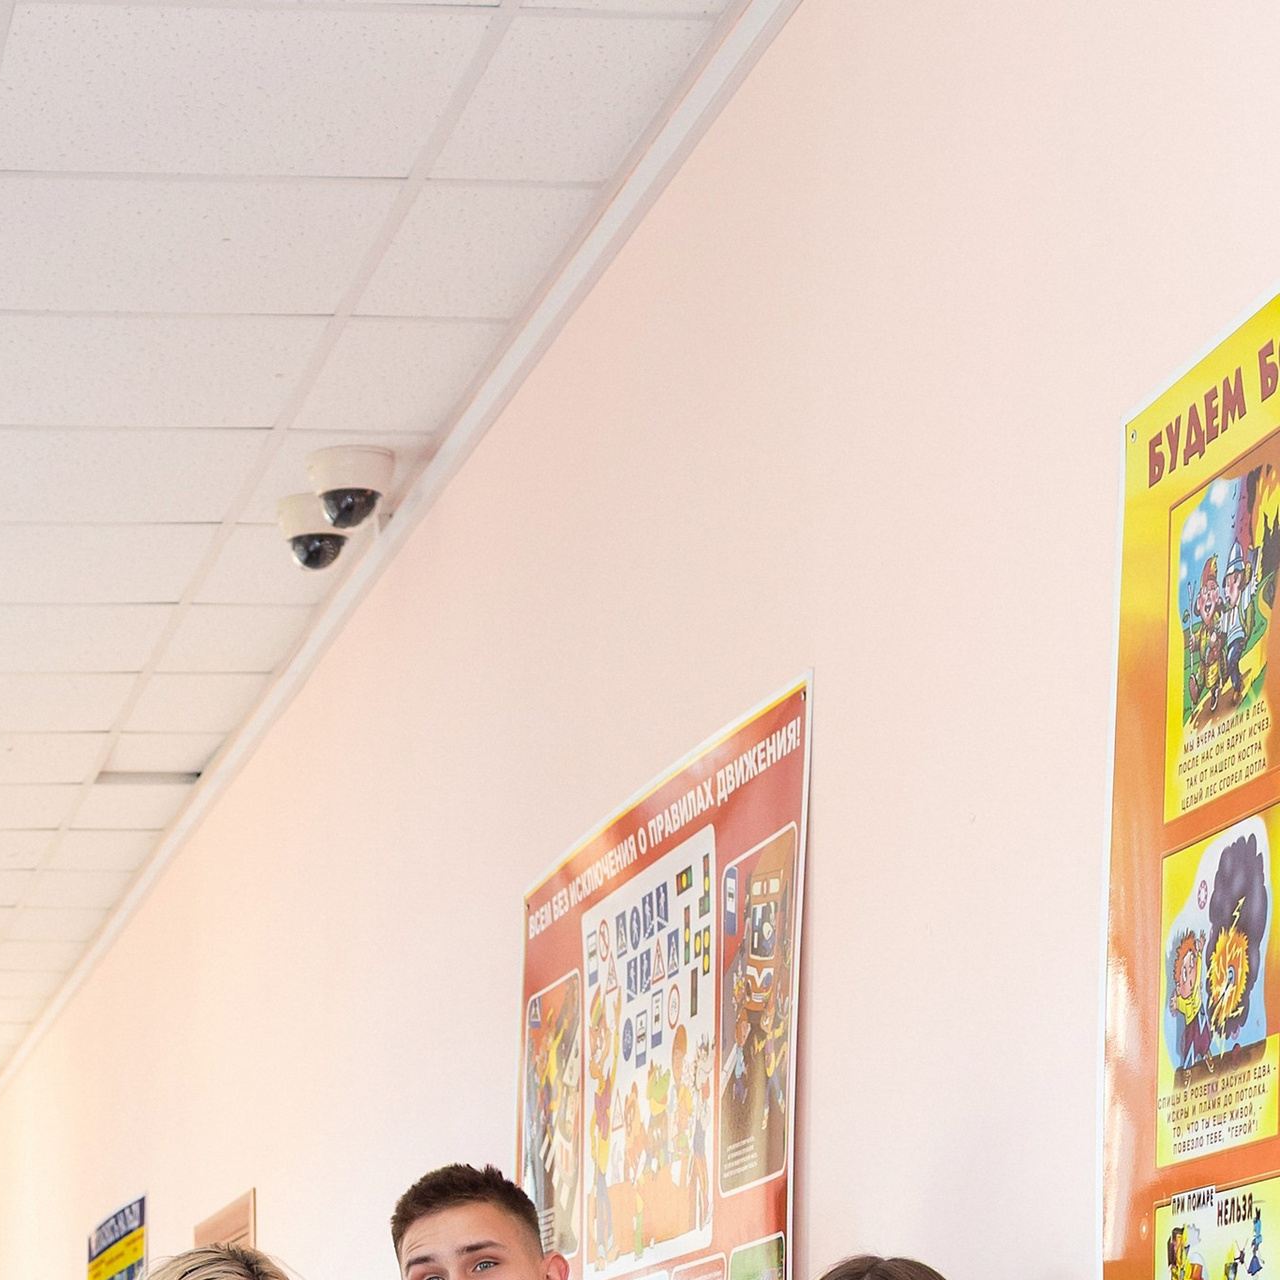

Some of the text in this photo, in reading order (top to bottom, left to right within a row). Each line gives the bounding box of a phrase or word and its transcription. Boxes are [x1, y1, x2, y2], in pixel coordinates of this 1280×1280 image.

[1148, 339, 1280, 488] БУДЕМ Б
[1178, 717, 1271, 776] ПОСЛЕ НАС ОН ВДРУГ ИСЧЕЗ.
[1184, 741, 1194, 754] МЫ
[1196, 729, 1215, 748] ВЧЕРА
[1217, 715, 1244, 736] ХОДИЛИ
[1252, 701, 1266, 717] ЛЕС,
[1182, 758, 1266, 811] ЦЕЛЫЙ ЛЕС СГОРЕЛ ДОТЛА
[1186, 741, 1262, 789] ТАК ОТ НАШЕГО КОСТРА
[529, 716, 800, 940] ВСЕМ БЕЗ ИСКЛЮЧЕНИЯ О ПРАВИЛАХ ДВИЖЕНИЯ!
[1158, 1094, 1181, 1110] СПИЦЫ
[1254, 1064, 1270, 1080] ЕДВА
[1167, 1110, 1188, 1124] ИСКРЫ
[1192, 1106, 1196, 1116] И
[1199, 1098, 1221, 1113] ПЛАМЯ
[1223, 1095, 1232, 1108] ДО
[1173, 1127, 1183, 1138] ТО,
[1187, 1121, 1198, 1133] ЧТО
[1202, 1116, 1210, 1129] ТЫ
[1213, 1110, 1226, 1126] ЕЩЕ
[1229, 1102, 1256, 1121] ЖИВОЙ,
[1173, 1136, 1203, 1155] ПОВЕЗЛО
[1206, 1130, 1224, 1143] ТЕБЕ,
[1172, 1189, 1253, 1227] ПРИ ПОЖАРЕ НЕЛЬЗЯ
